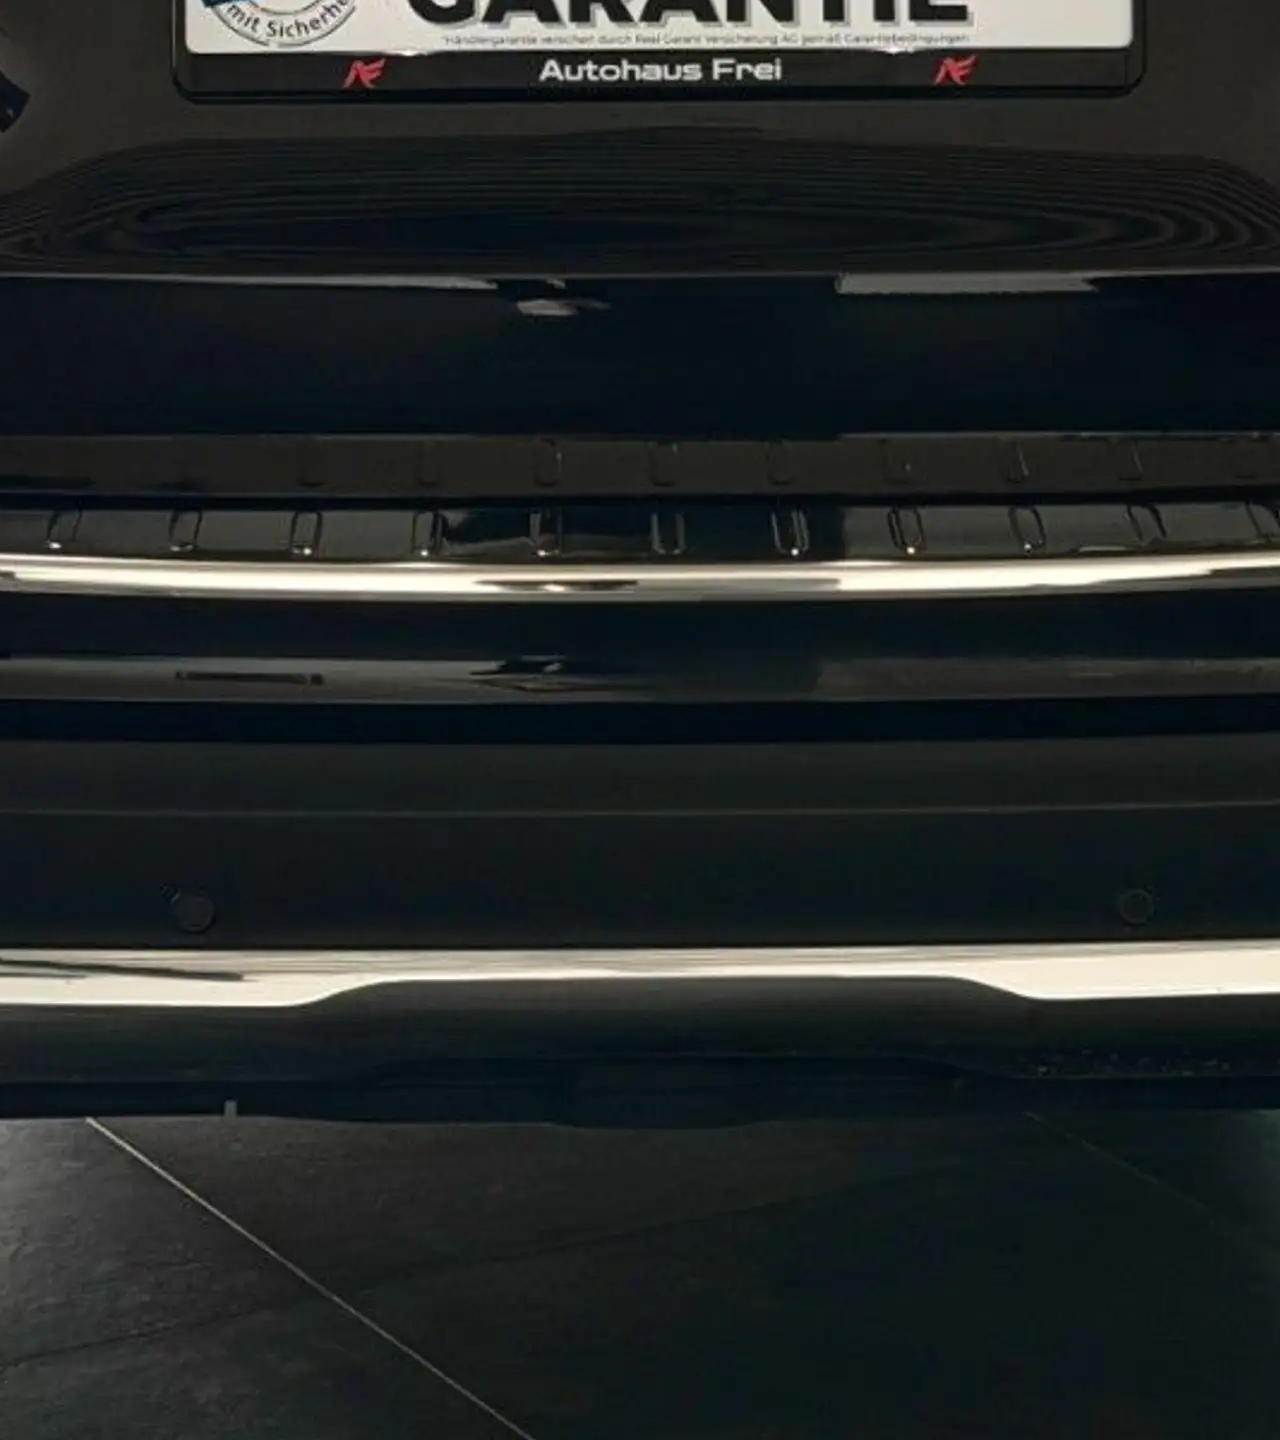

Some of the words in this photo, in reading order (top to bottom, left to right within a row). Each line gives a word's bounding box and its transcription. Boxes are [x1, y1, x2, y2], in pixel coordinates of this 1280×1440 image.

[226, 3, 261, 33] mit
[538, 58, 703, 82] Autohaus
[712, 58, 782, 81] Frei
